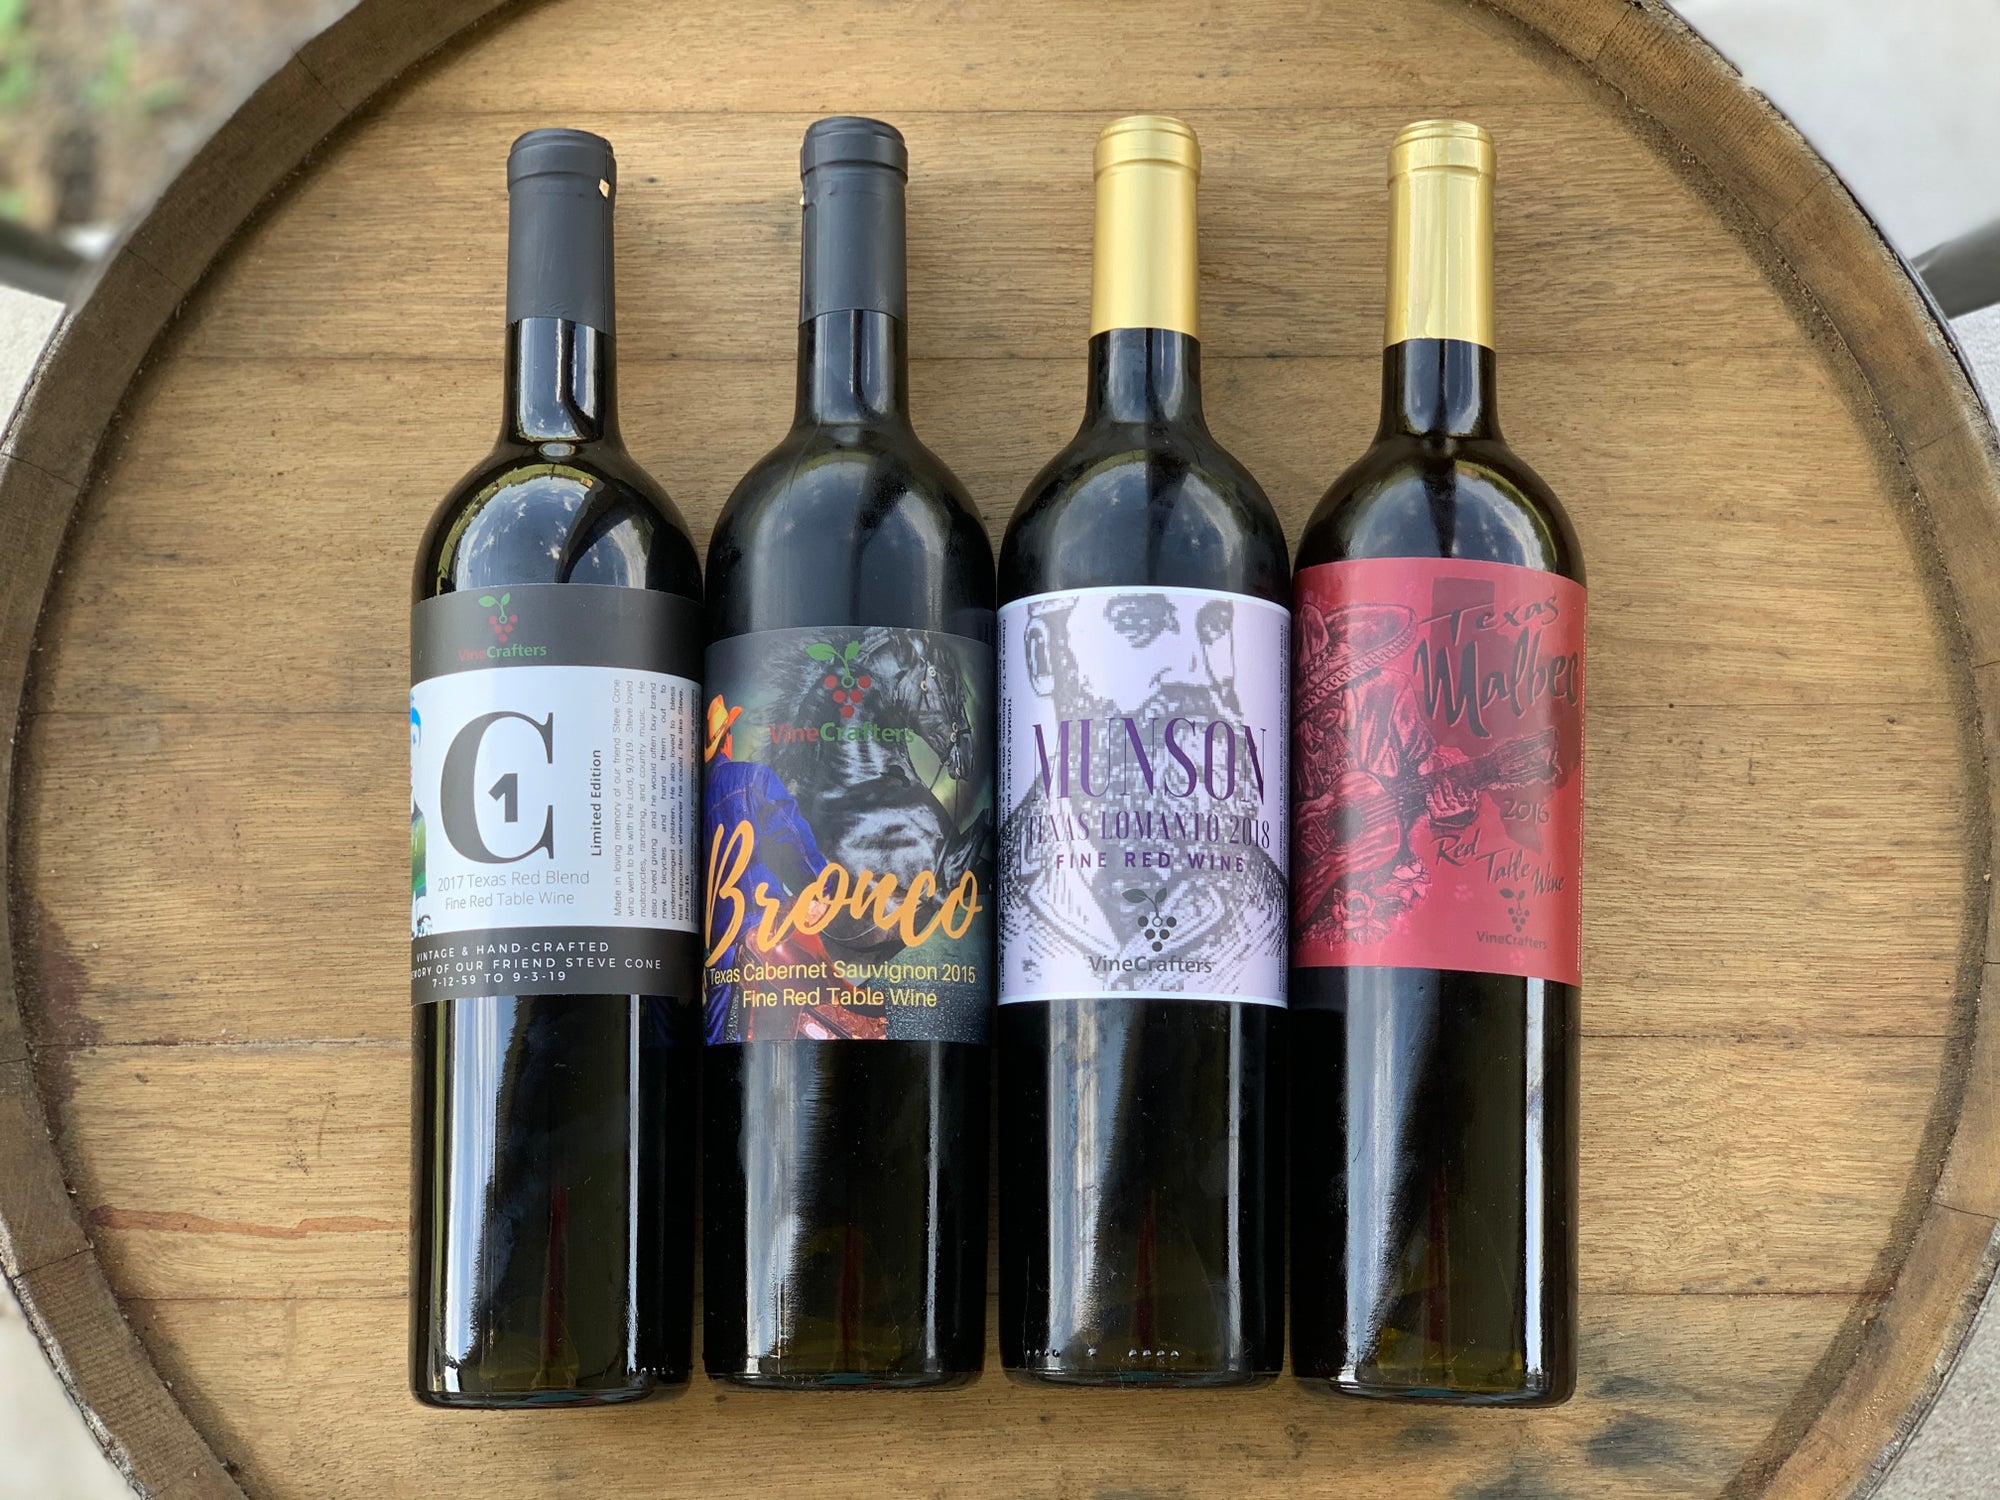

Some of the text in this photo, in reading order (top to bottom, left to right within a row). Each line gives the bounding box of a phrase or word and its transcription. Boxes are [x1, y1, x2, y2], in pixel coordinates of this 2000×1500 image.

[1418, 593, 1560, 646] Texas
[458, 643, 547, 662] VineCrafters
[639, 681, 647, 694] He
[661, 685, 667, 693] to
[670, 720, 676, 729] to
[769, 722, 914, 745] VineCrafters
[639, 743, 647, 778] country
[1032, 717, 1267, 805] MUNSON
[612, 679, 622, 916] Made in loving memory of our friend Steve Cone
[626, 777, 634, 800] Lord,
[638, 784, 646, 802] and
[670, 786, 676, 799] He
[591, 750, 602, 856] Limited Edition
[626, 803, 634, 818] the
[651, 795, 657, 807] he
[1503, 797, 1550, 824] 2016
[626, 822, 634, 841] with
[639, 808, 647, 852] ranching,
[1027, 810, 1270, 849] TEXAS LOMANTO 2018
[626, 844, 634, 856] be
[1431, 829, 1480, 866] Red
[626, 858, 634, 867] to
[1056, 851, 1244, 873] FINE RED WINE
[1477, 850, 1530, 884] Table
[437, 870, 589, 892] 2017 Texas Red Blend
[627, 871, 635, 893] went
[639, 858, 647, 917] motorcycles,
[1531, 867, 1567, 897] Wine
[445, 891, 575, 910] Fine Red Table Wine
[704, 820, 983, 967] Bronco
[627, 897, 635, 917] who
[1476, 931, 1548, 950] VineCrafters
[416, 942, 610, 963] VINTAGE & HAND-CRAFTED
[436, 964, 450, 975] OF
[455, 961, 483, 972] OUR
[493, 958, 556, 969] FRIEND
[566, 957, 616, 968] STEVE
[625, 959, 662, 970] CONE
[710, 960, 977, 985] Texas Cabernet Sauvignon 2015
[1088, 955, 1213, 974] VineCrafters
[432, 972, 567, 989] 7-12-59 TO 9-3-19
[743, 987, 938, 1008] Fine Red Table Wine
